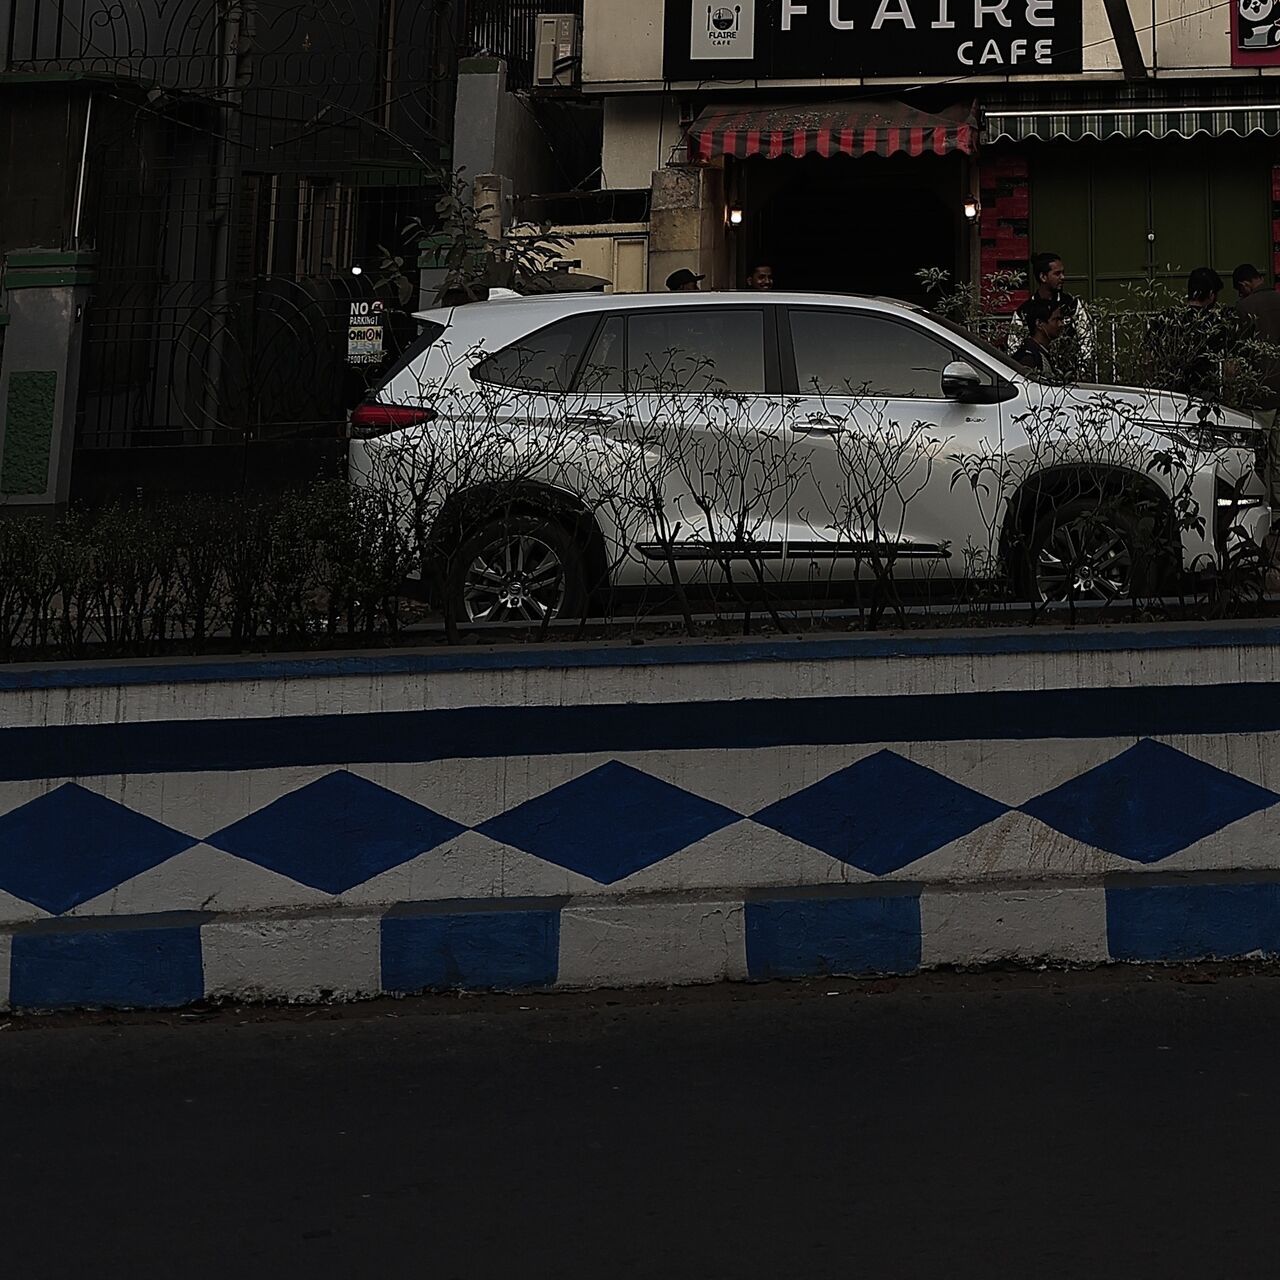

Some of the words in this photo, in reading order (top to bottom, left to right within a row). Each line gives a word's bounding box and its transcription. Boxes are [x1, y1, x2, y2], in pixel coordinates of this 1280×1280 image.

[708, 31, 737, 39] FLAIRE
[956, 39, 1053, 66] CAFE
[350, 301, 369, 315] NO
[349, 328, 382, 341] ORION
